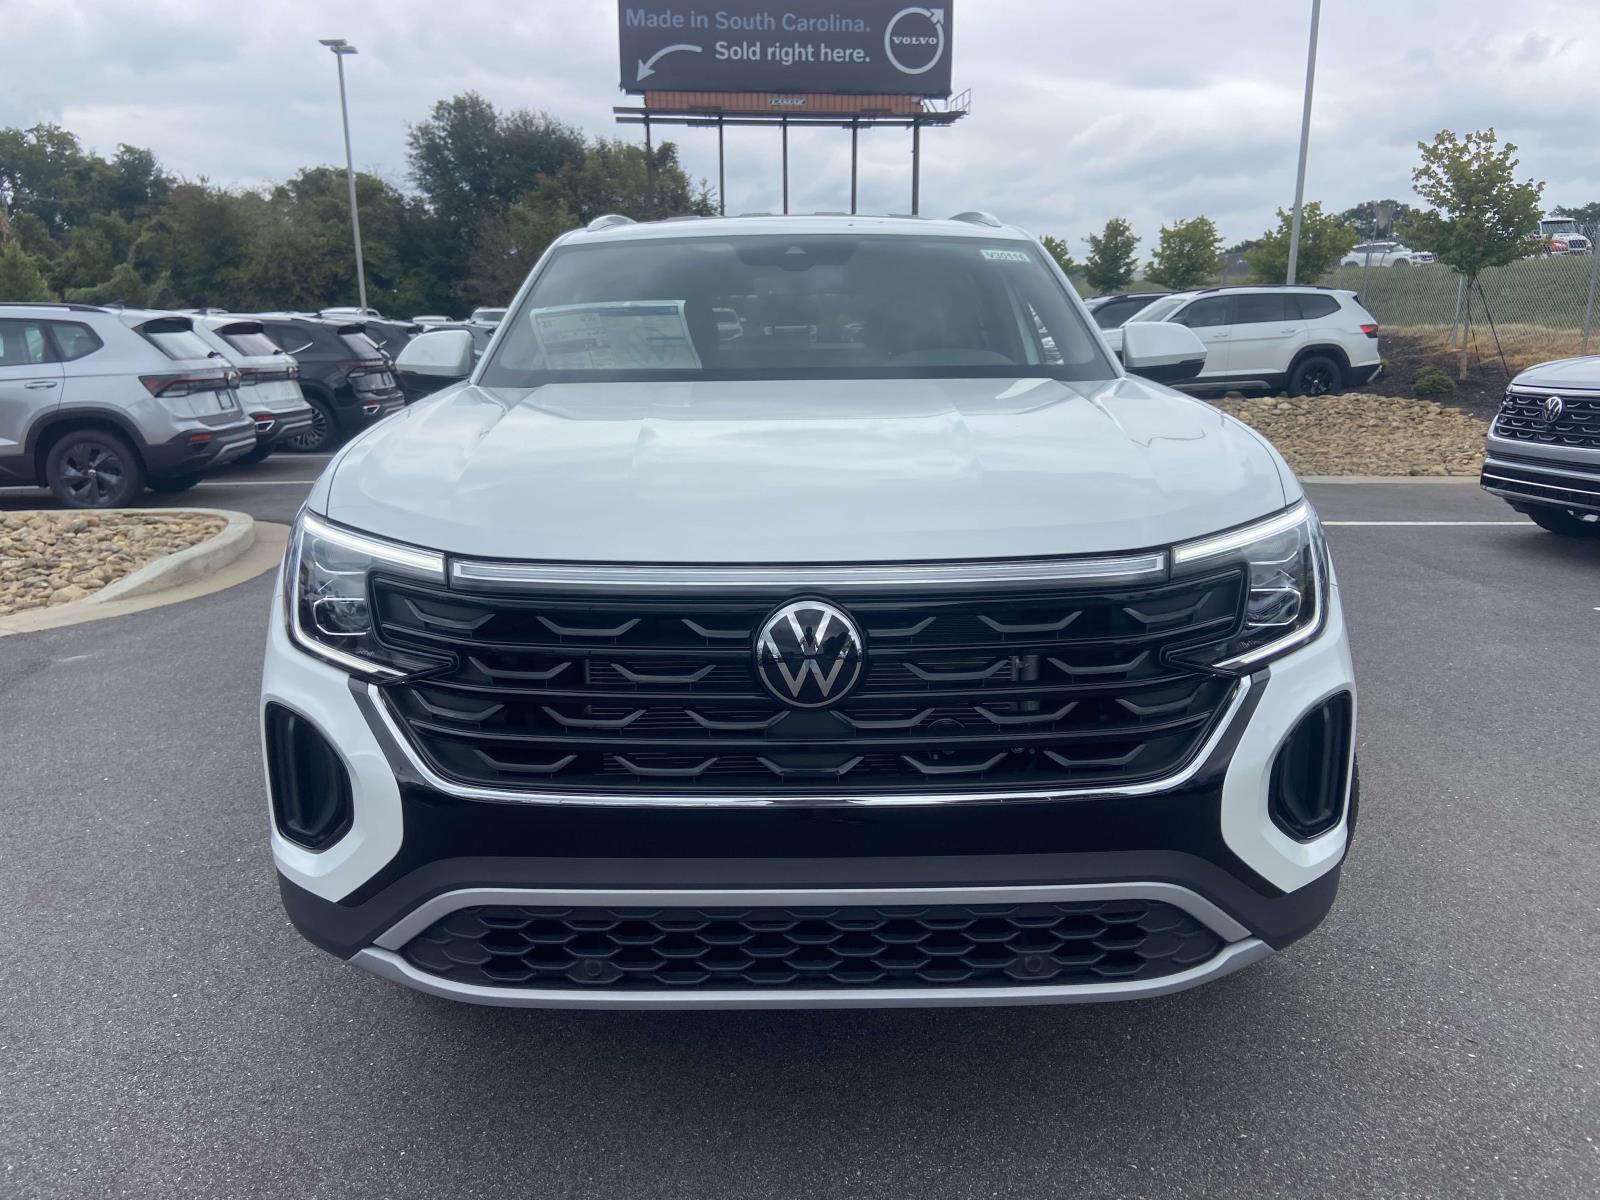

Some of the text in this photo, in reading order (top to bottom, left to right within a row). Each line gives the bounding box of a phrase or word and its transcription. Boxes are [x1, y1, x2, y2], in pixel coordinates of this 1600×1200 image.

[625, 8, 871, 32] Made in South Carolina.
[891, 36, 938, 45] VOLVO
[714, 40, 871, 66] Sold right here.
